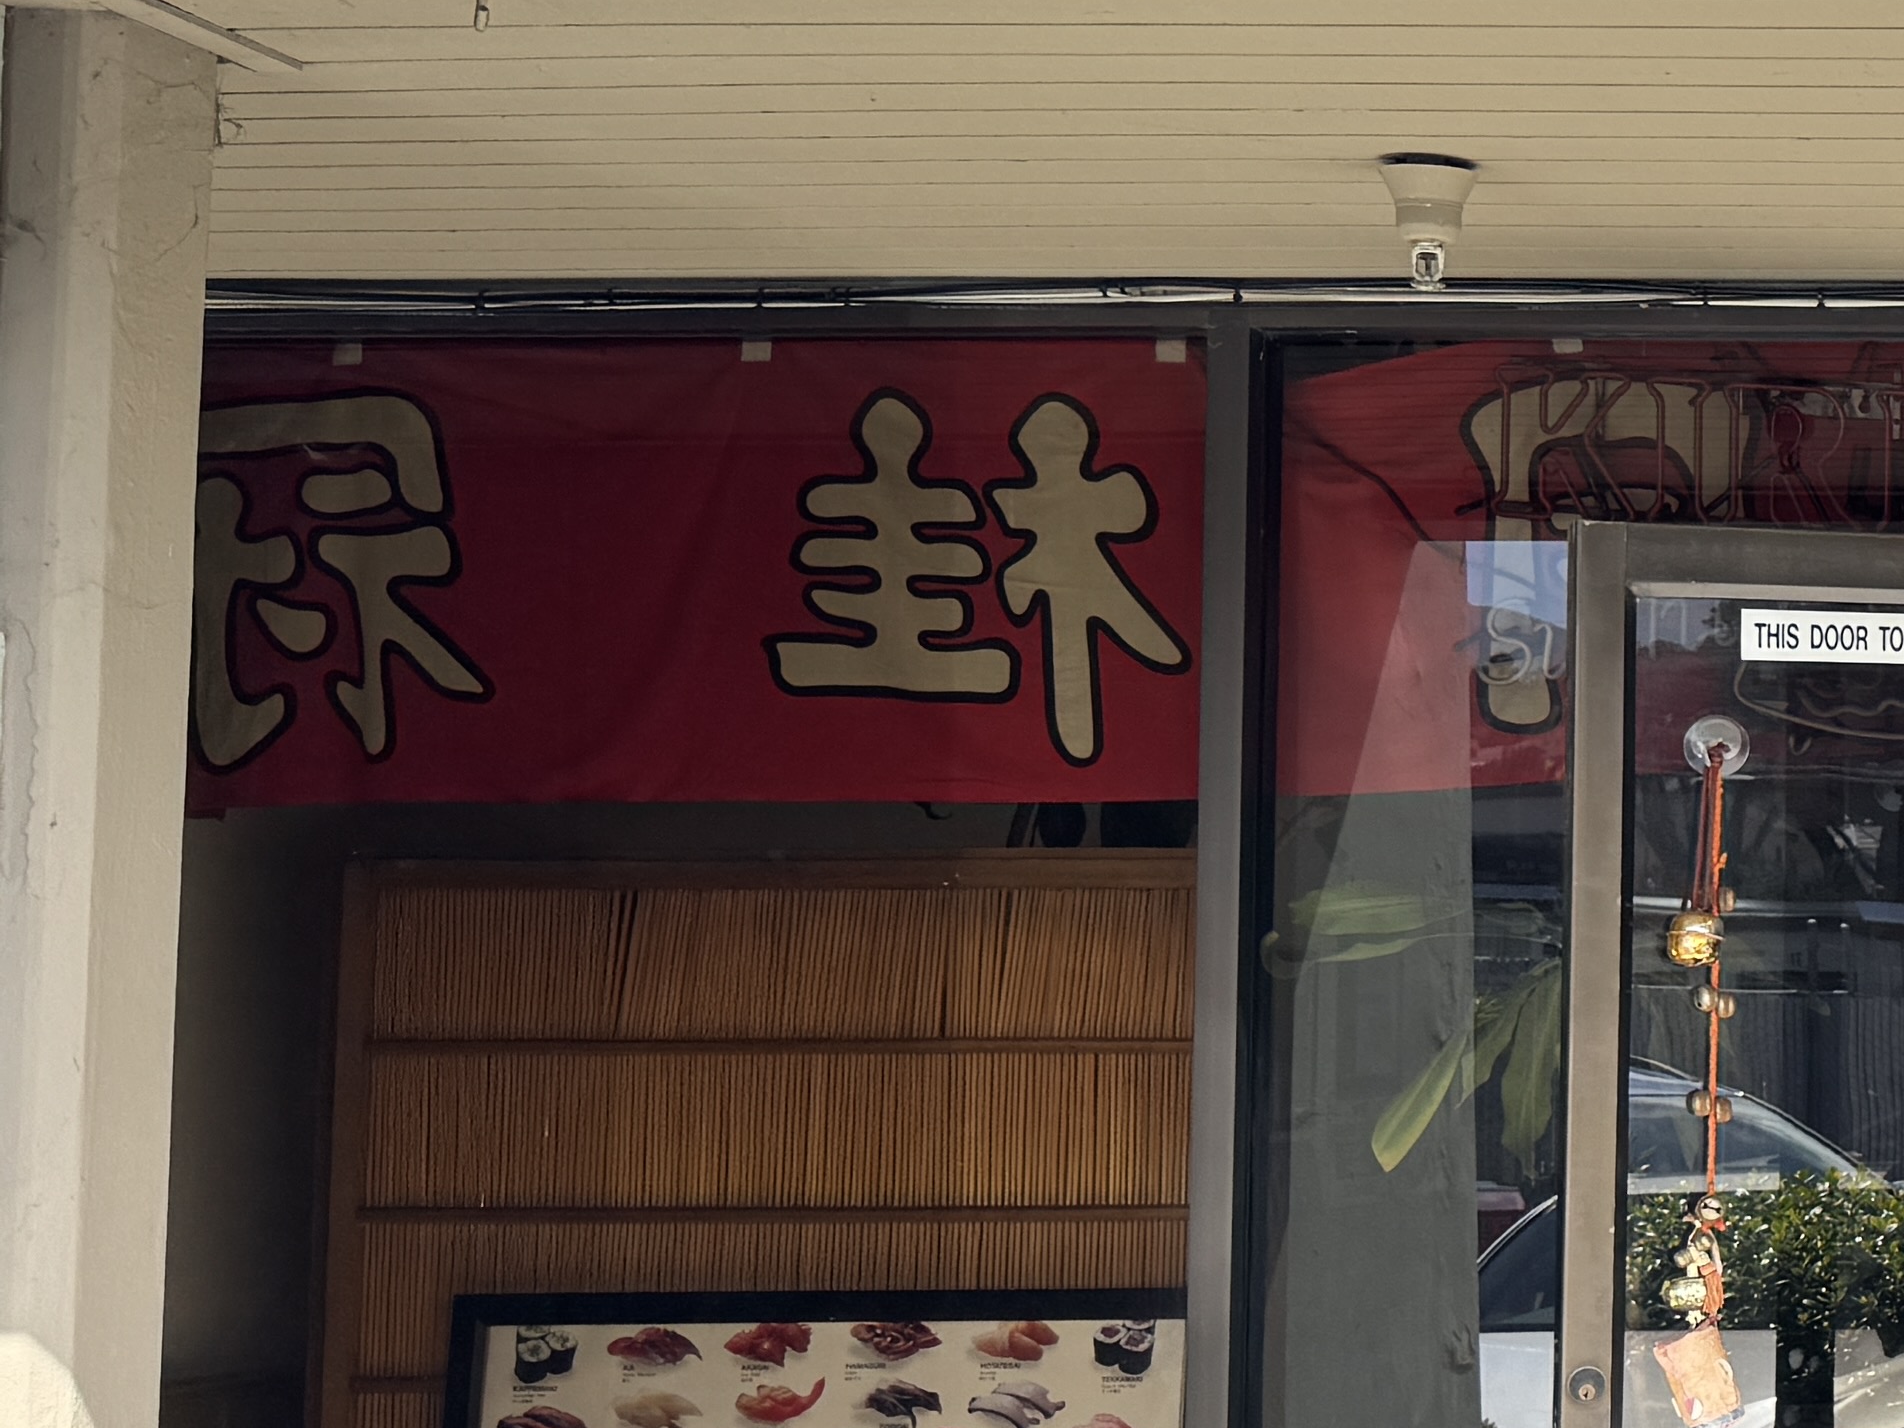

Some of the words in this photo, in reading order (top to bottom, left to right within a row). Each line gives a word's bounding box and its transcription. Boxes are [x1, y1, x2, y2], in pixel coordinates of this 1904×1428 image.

[1754, 622, 1800, 650] THIS
[1810, 623, 1868, 652] DOOR
[1879, 625, 1904, 652] TO
